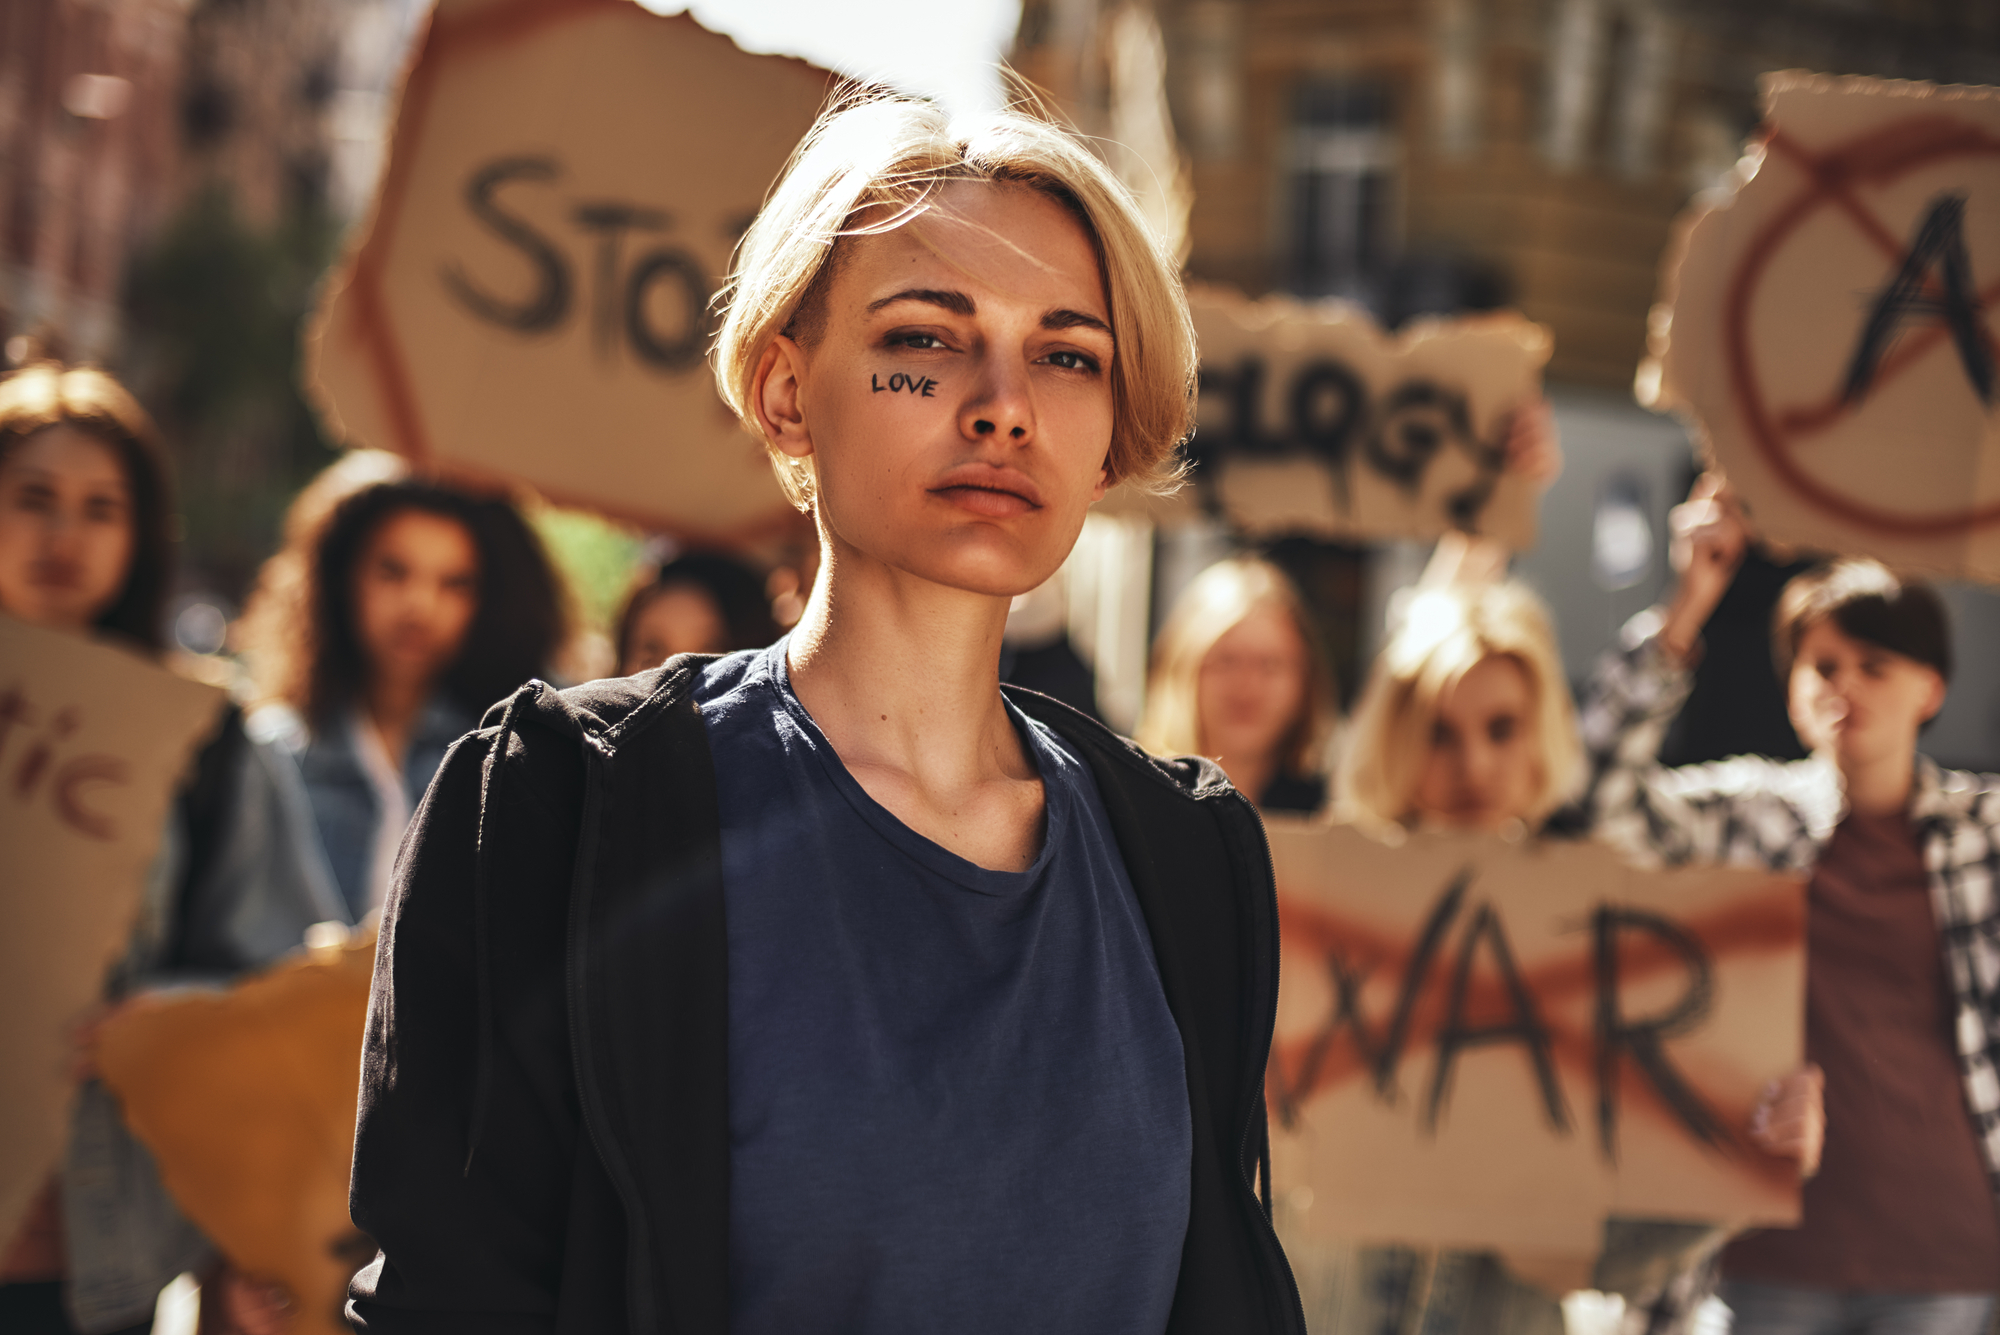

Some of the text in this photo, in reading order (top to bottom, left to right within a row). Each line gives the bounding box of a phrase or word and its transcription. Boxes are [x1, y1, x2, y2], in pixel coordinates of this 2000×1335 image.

[440, 152, 756, 376] STO
[871, 372, 939, 397] LOVE
[1268, 868, 1738, 1168] WAR
